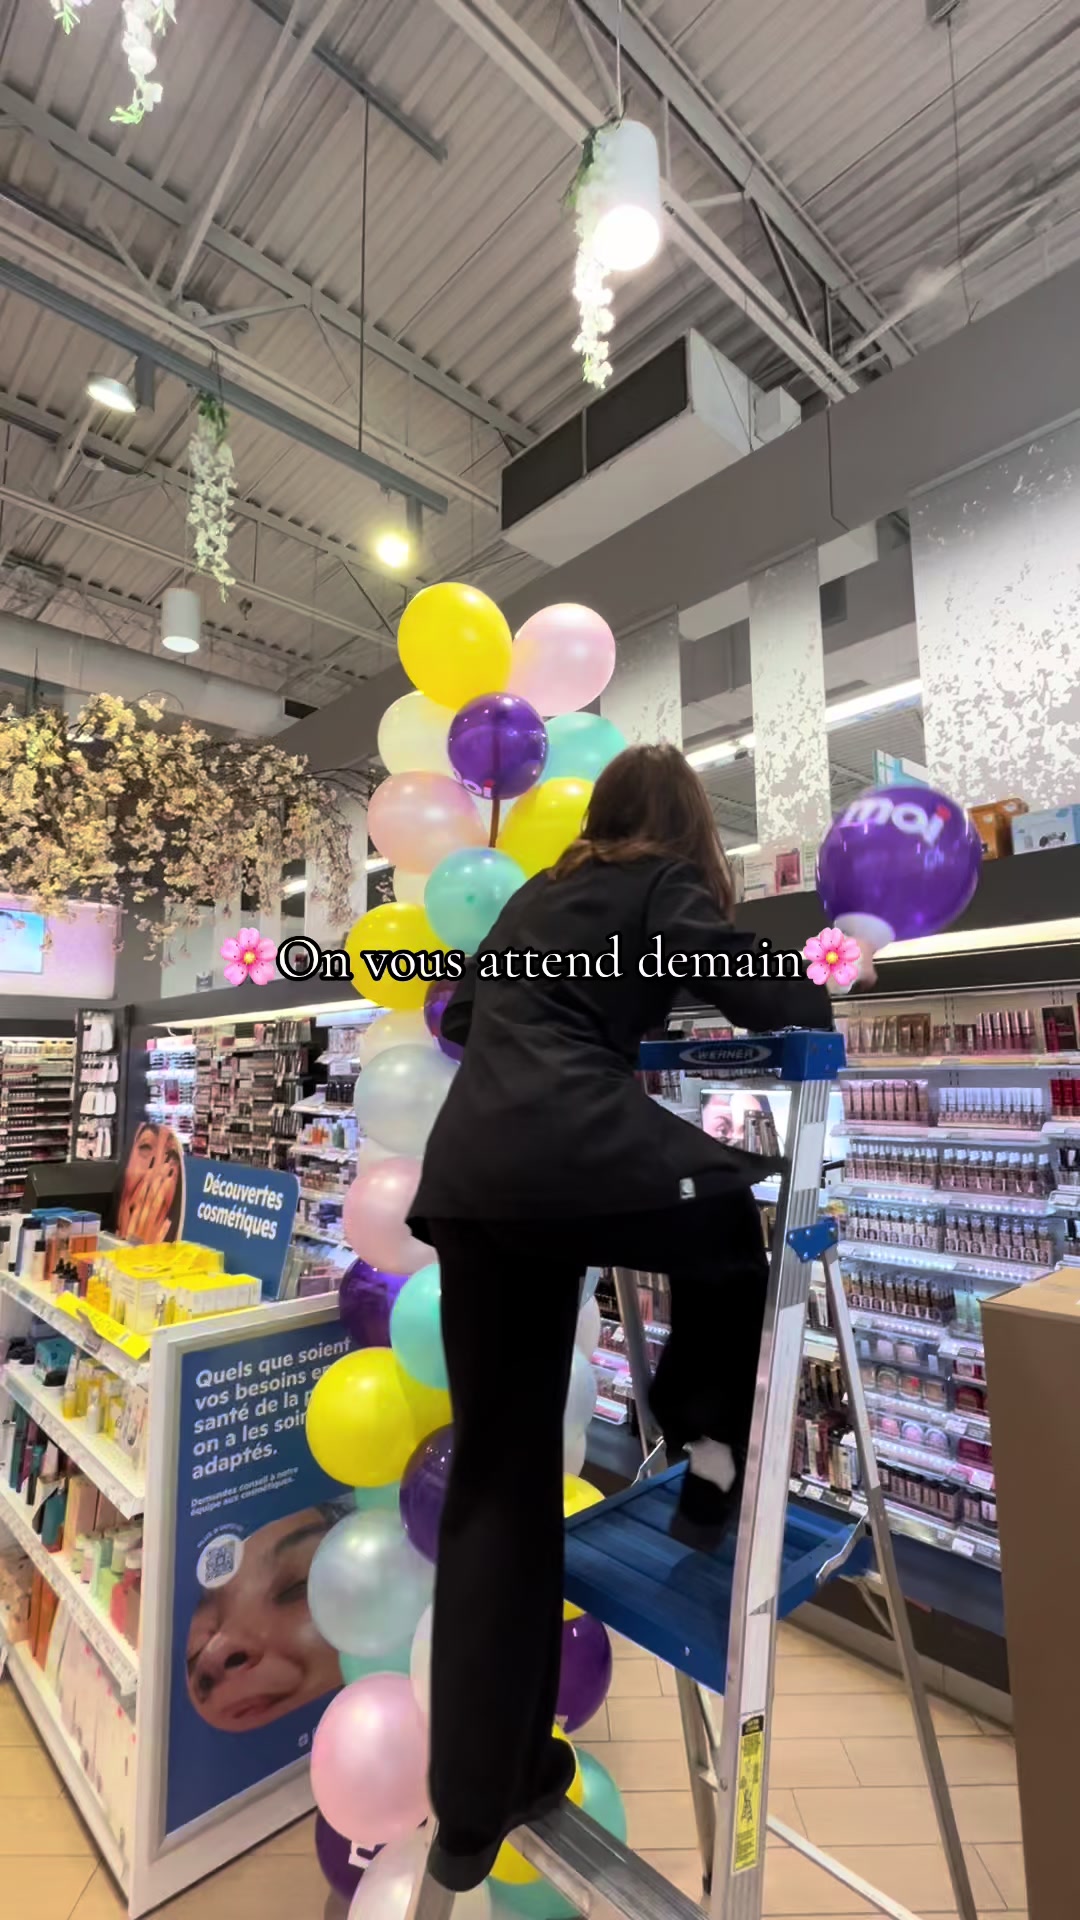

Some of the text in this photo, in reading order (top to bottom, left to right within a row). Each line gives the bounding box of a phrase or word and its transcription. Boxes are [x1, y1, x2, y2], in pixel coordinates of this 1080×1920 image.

[839, 796, 952, 846] moi
[698, 1047, 754, 1061] WERNER
[203, 1171, 284, 1211] Découvertes
[197, 1202, 278, 1240] cosmétiques
[195, 1336, 352, 1388] Quels que soient
[194, 1390, 229, 1411] vos
[235, 1371, 306, 1400] besoins
[194, 1402, 249, 1434] santé
[255, 1398, 278, 1417] de
[283, 1392, 298, 1409] la
[192, 1438, 219, 1457] on
[225, 1432, 236, 1447] a
[242, 1424, 269, 1442] les
[192, 1442, 278, 1480] adaptés.
